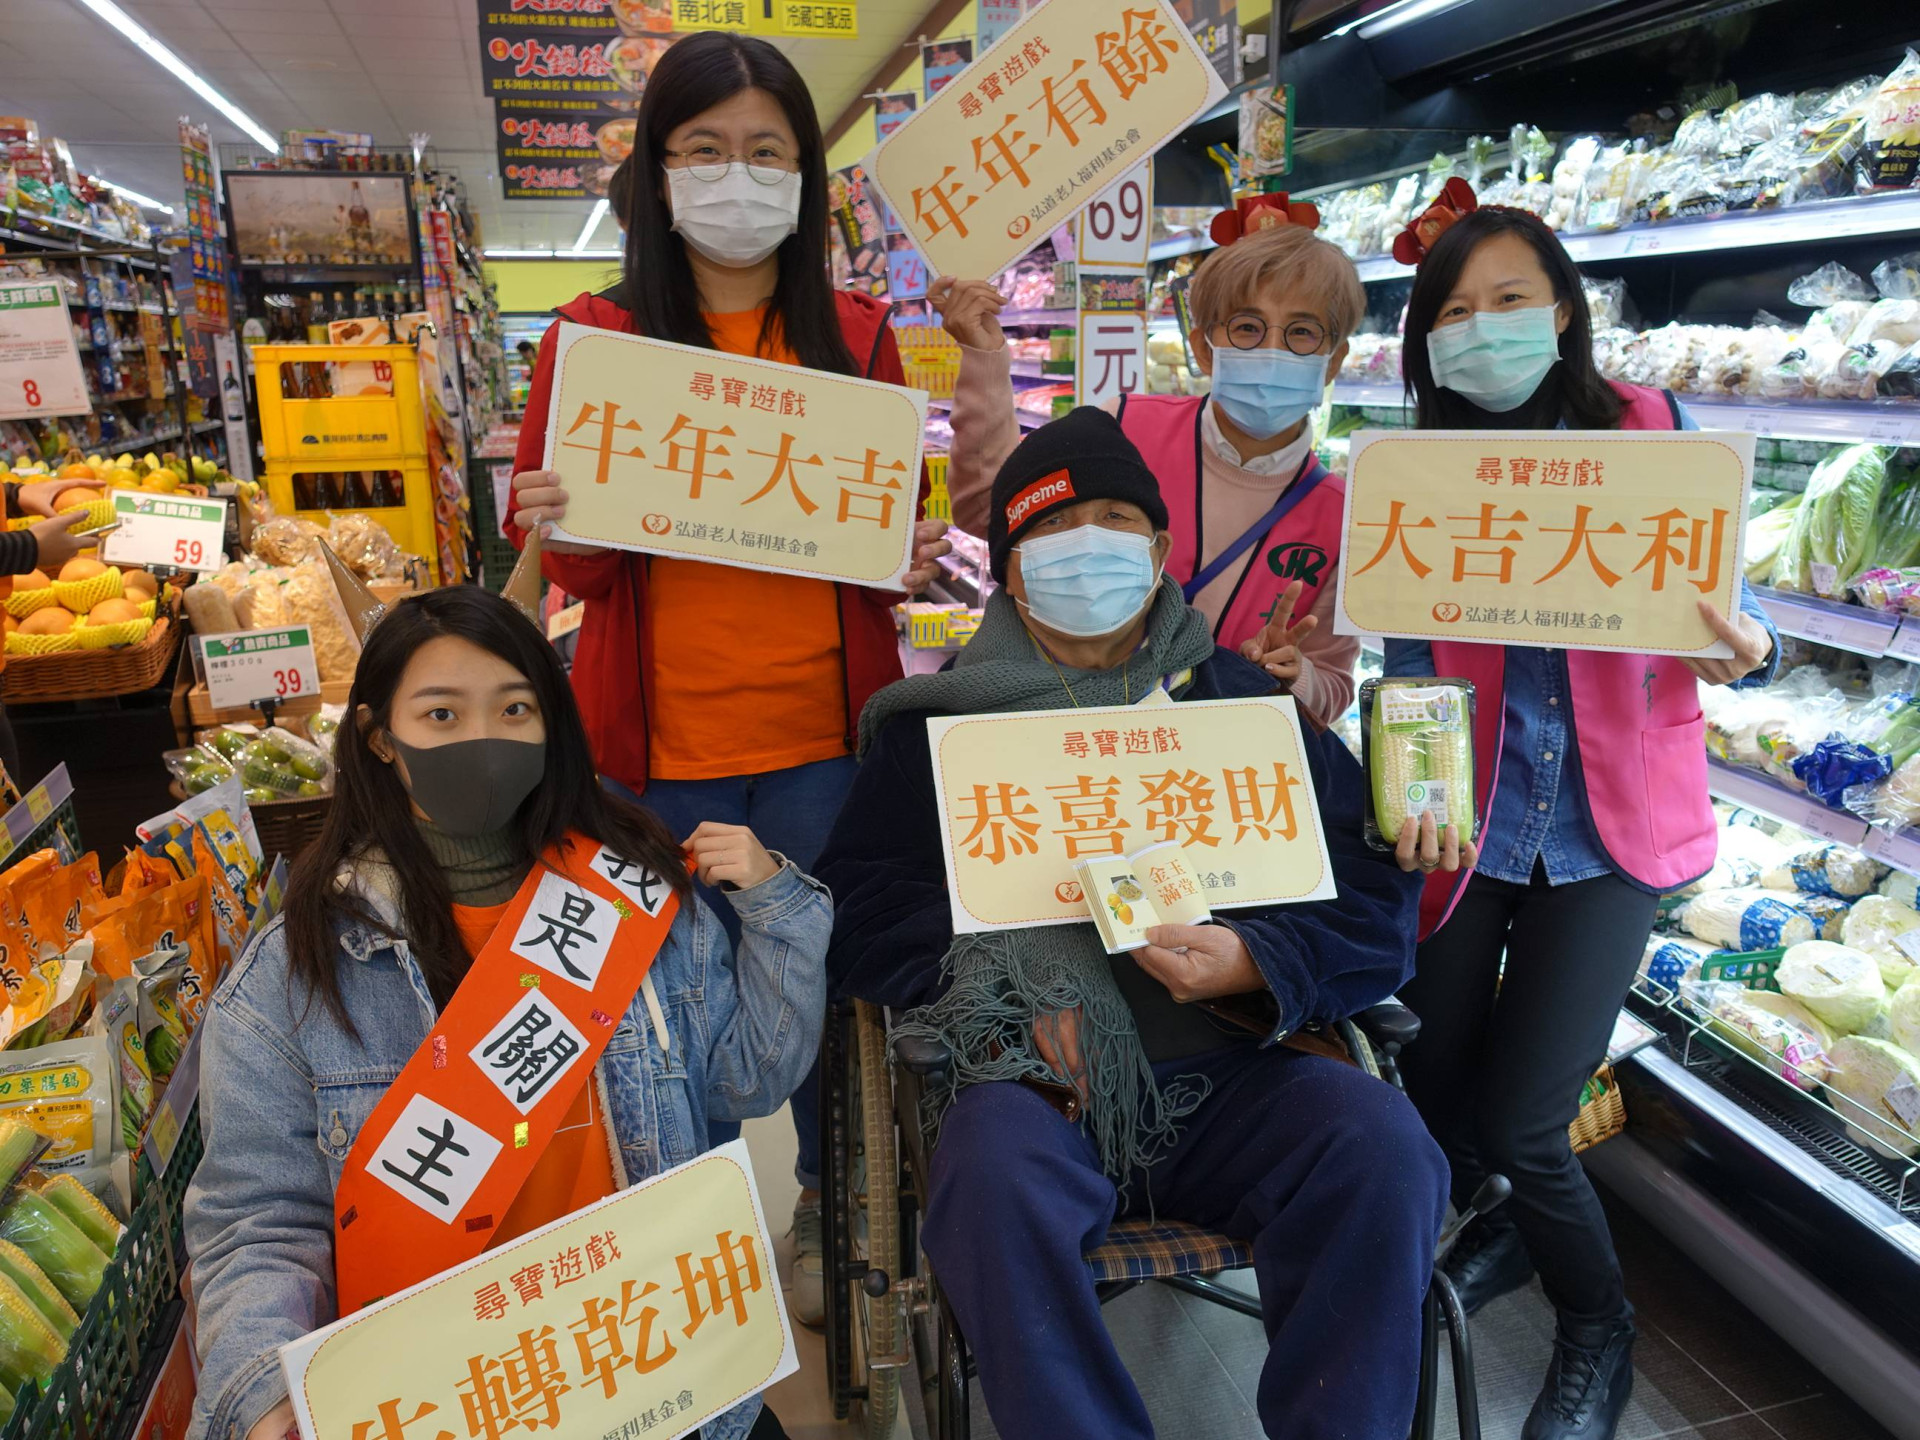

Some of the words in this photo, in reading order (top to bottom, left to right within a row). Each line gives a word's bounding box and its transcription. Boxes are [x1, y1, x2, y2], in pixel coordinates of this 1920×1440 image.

[678, 0, 746, 25] 南北貨
[787, 5, 852, 29] 冷藏日配品
[956, 35, 1052, 120] 尋寶遊戲
[911, 7, 1180, 243] 年年有餘
[1030, 127, 1142, 222] 弘道老人福利基金會
[1089, 181, 1143, 242] 69
[1093, 327, 1137, 394] 元
[22, 379, 42, 407] 8
[689, 371, 806, 417] 尋寶遊戲
[562, 401, 907, 529] 牛年大吉
[1475, 456, 1604, 487] 尋寶遊戲
[1007, 480, 1067, 525] Supreme
[174, 539, 203, 564] 59
[675, 520, 819, 557] 弘道老人福利基金會
[1352, 500, 1730, 594] 大吉大利
[1465, 605, 1623, 630] 弘道老人福利基金會
[274, 668, 302, 695] 39
[1062, 726, 1181, 758] 尋寶遊戲
[956, 762, 1300, 865] 恭喜發財
[1197, 871, 1236, 889] 金會
[472, 1230, 622, 1321] 尋寶遊戲
